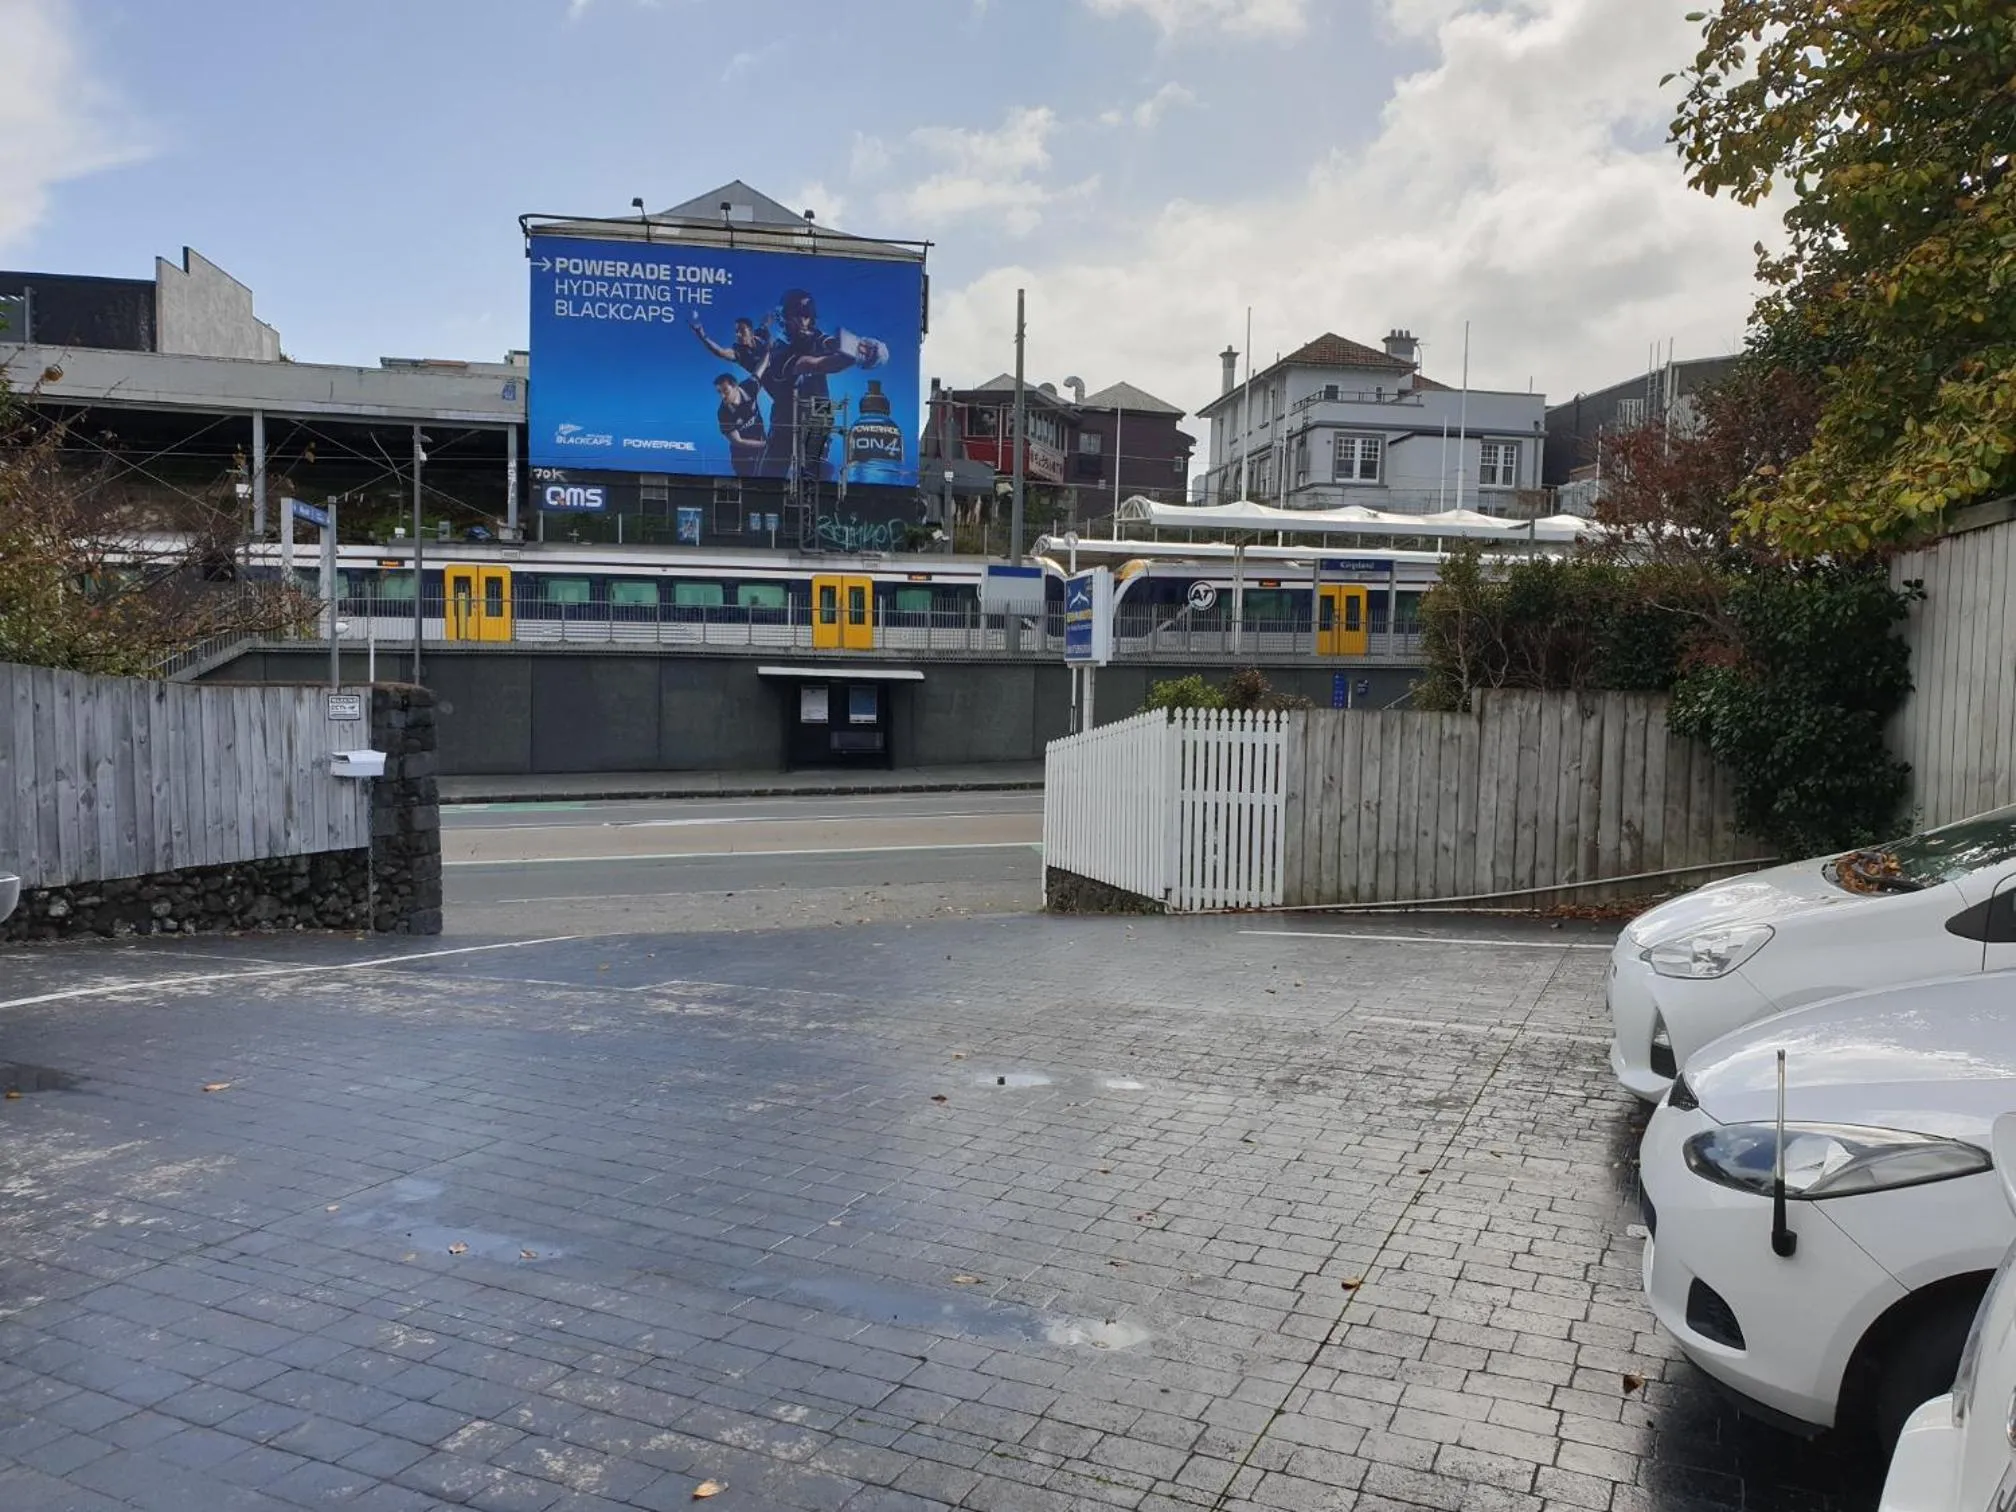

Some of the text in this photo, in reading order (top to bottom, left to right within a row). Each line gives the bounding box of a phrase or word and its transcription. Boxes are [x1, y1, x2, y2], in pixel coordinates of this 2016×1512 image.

[555, 257, 732, 285] POWERADE ION4:
[555, 278, 712, 305] HYDRATING THE
[555, 299, 674, 323] BLACKCAPS
[556, 435, 613, 446] BLACKCAPS
[623, 438, 697, 451] POWERADE
